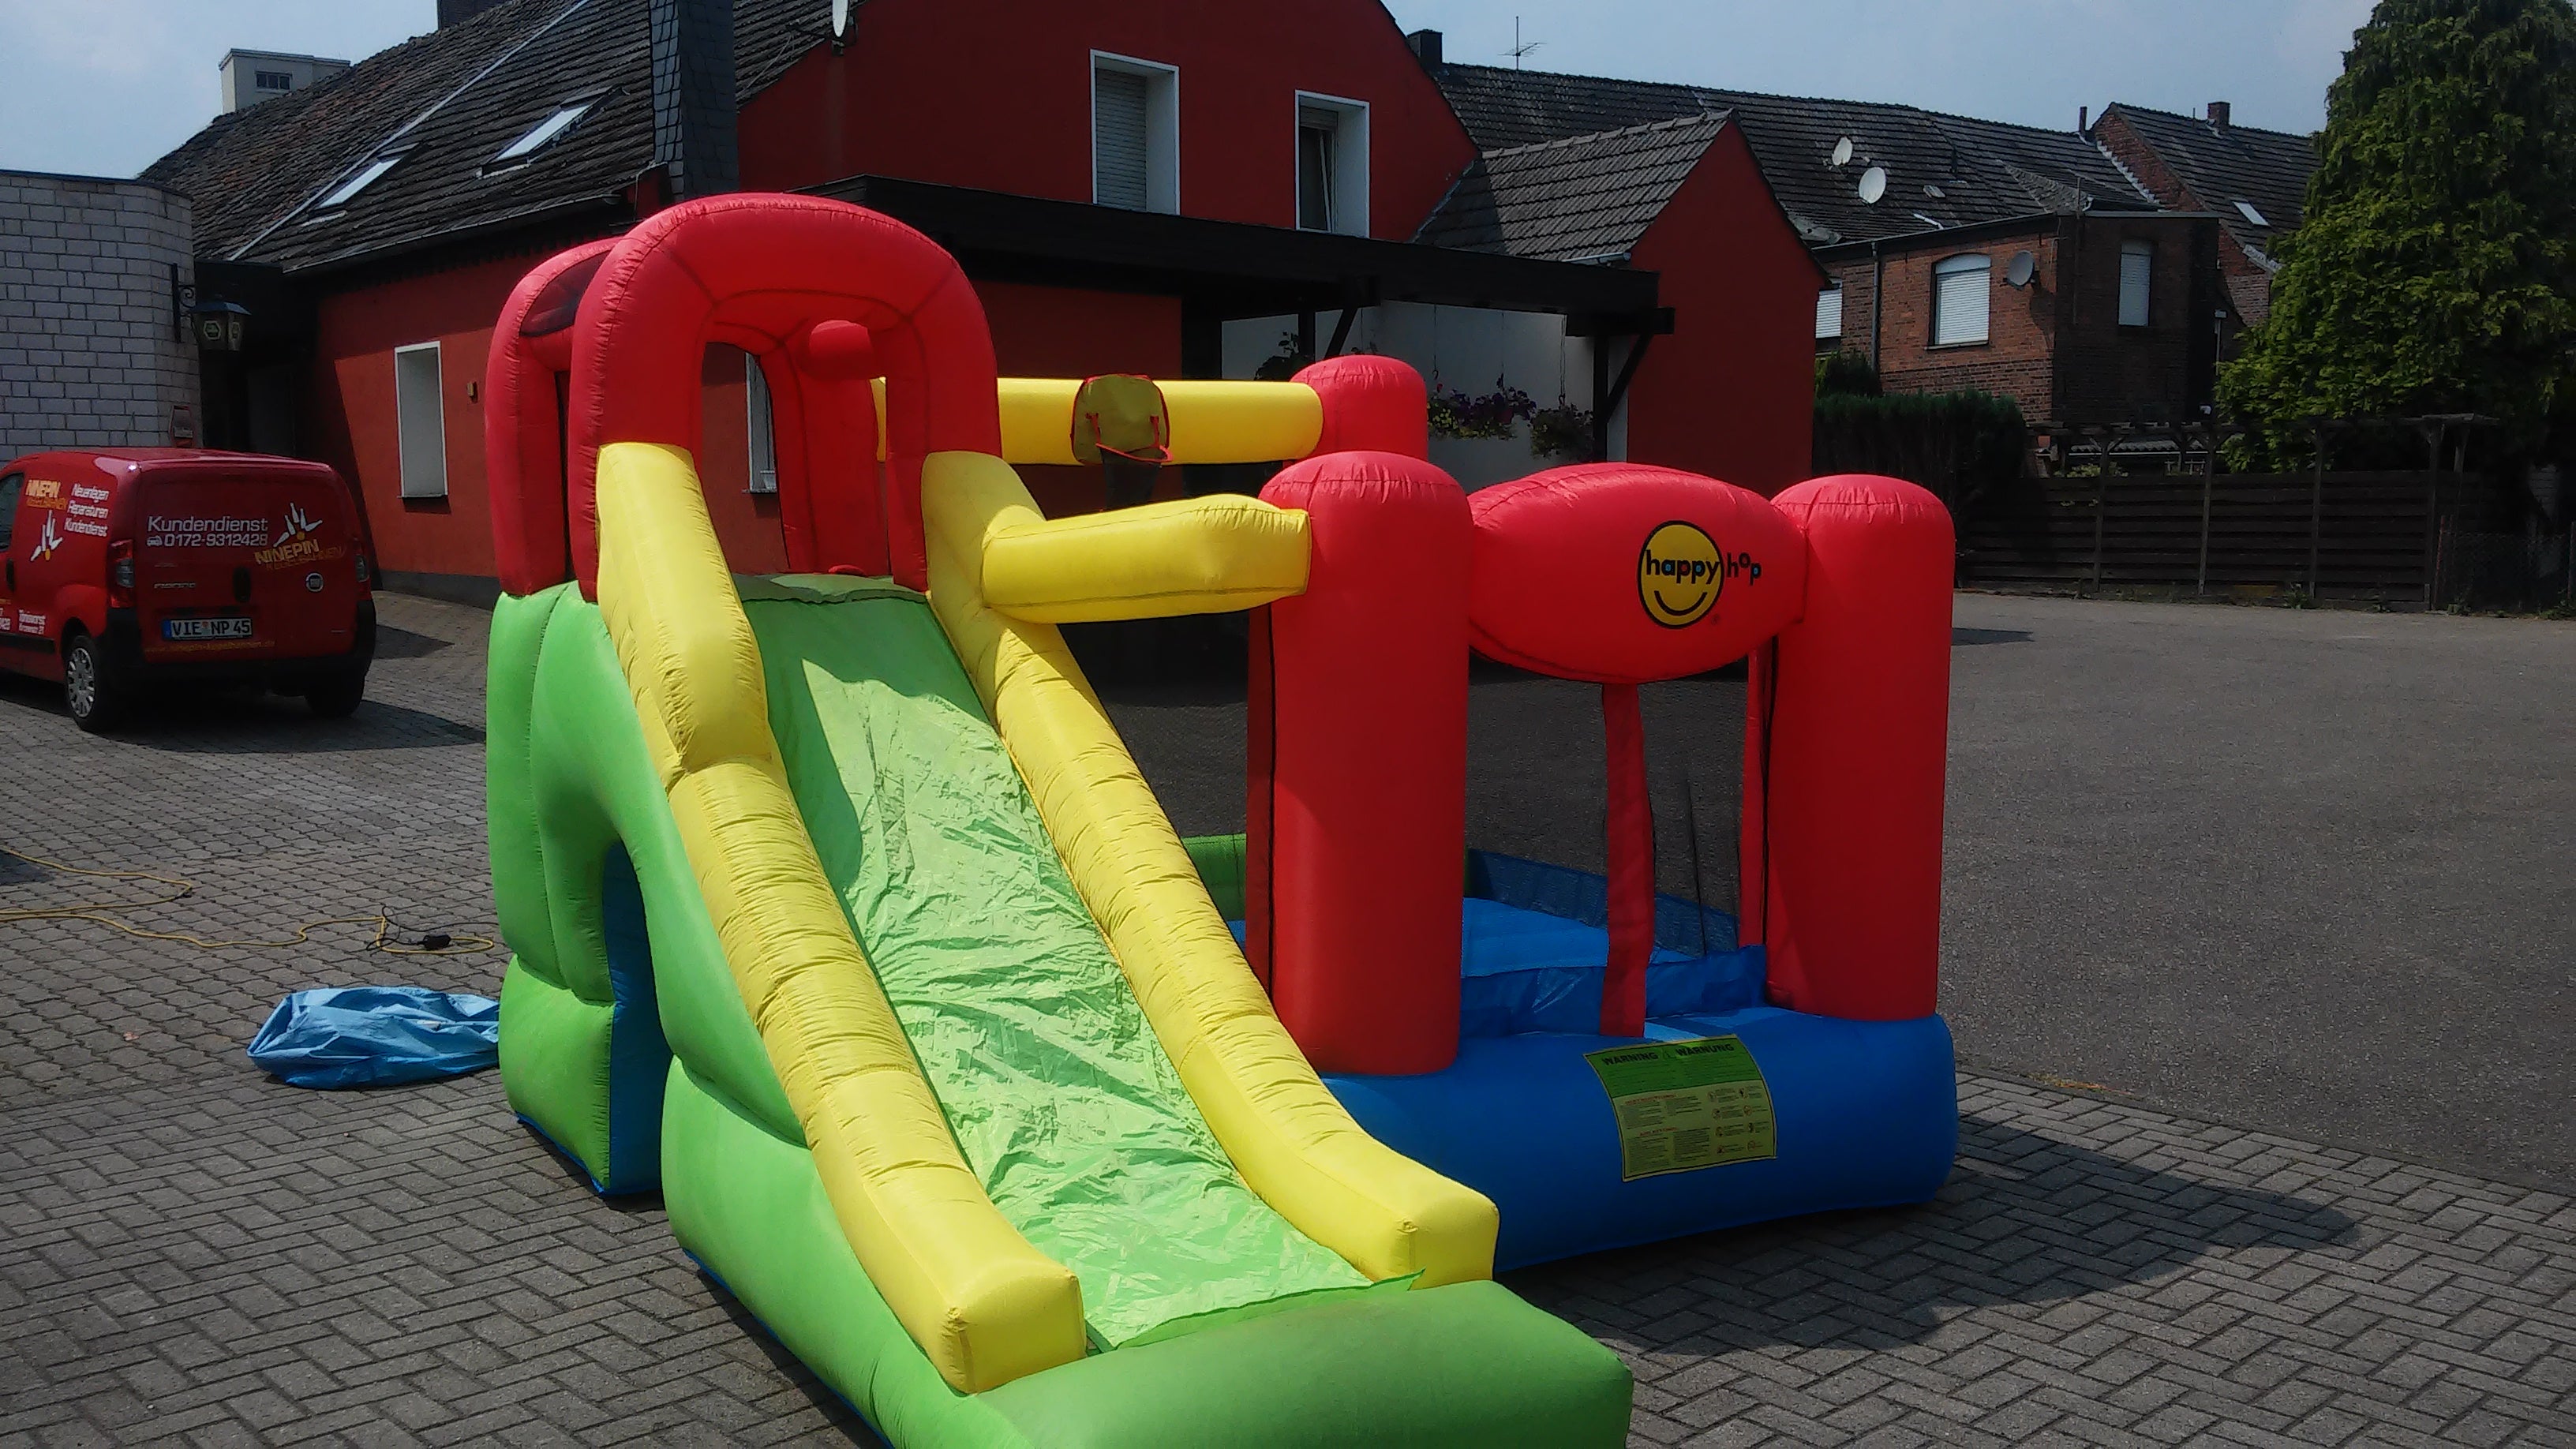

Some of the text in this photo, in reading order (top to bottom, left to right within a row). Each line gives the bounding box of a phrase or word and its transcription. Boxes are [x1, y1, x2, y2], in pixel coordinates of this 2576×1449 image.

[64, 517, 108, 537] Kundendienst
[148, 515, 268, 532] Kundendienst
[164, 534, 268, 547] 0172-9312428
[253, 539, 319, 564] NINEPIN
[1645, 549, 1762, 586] happy hop
[170, 620, 251, 635] VIE NP 45
[1602, 1043, 1735, 1065] WARNING WARNUNG
